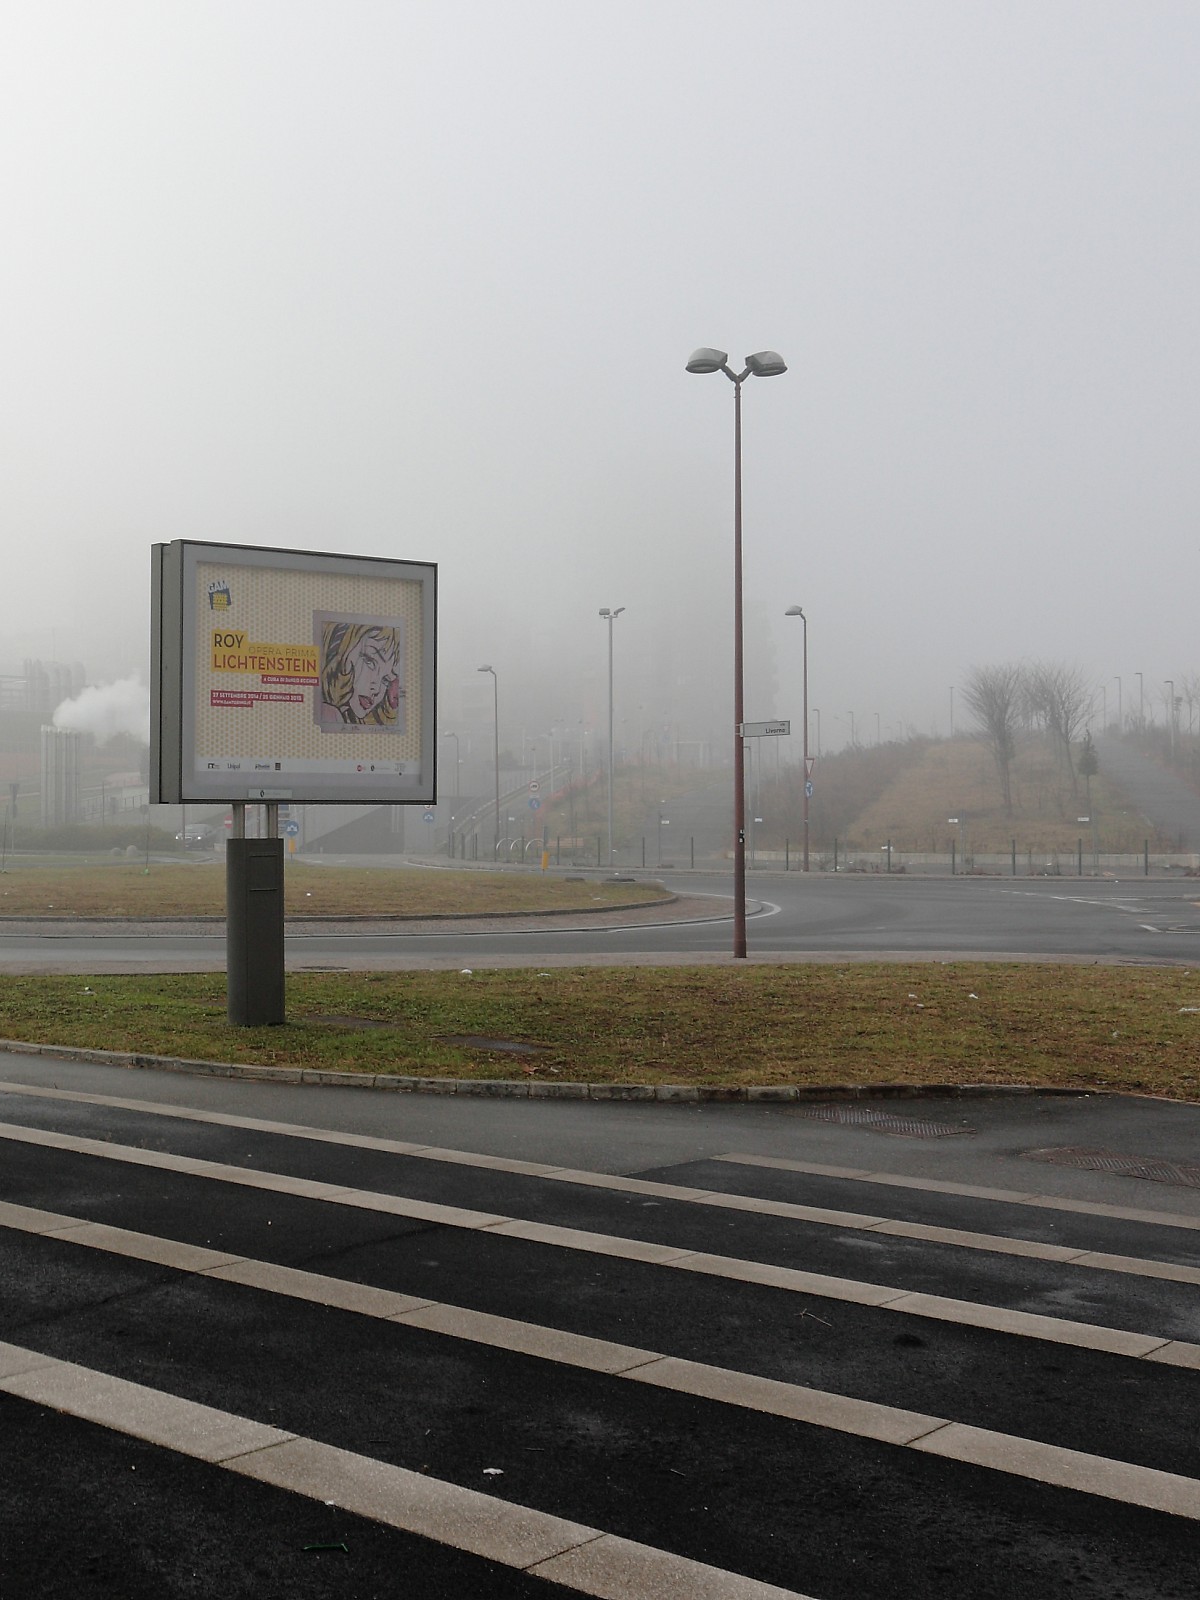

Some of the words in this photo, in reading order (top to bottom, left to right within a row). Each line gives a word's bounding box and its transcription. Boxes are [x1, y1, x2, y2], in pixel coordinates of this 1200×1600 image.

[214, 633, 244, 648] ROY
[248, 646, 282, 656] OPERA
[285, 648, 317, 658] PRIMA
[214, 654, 317, 672] LICHTENSTEIN
